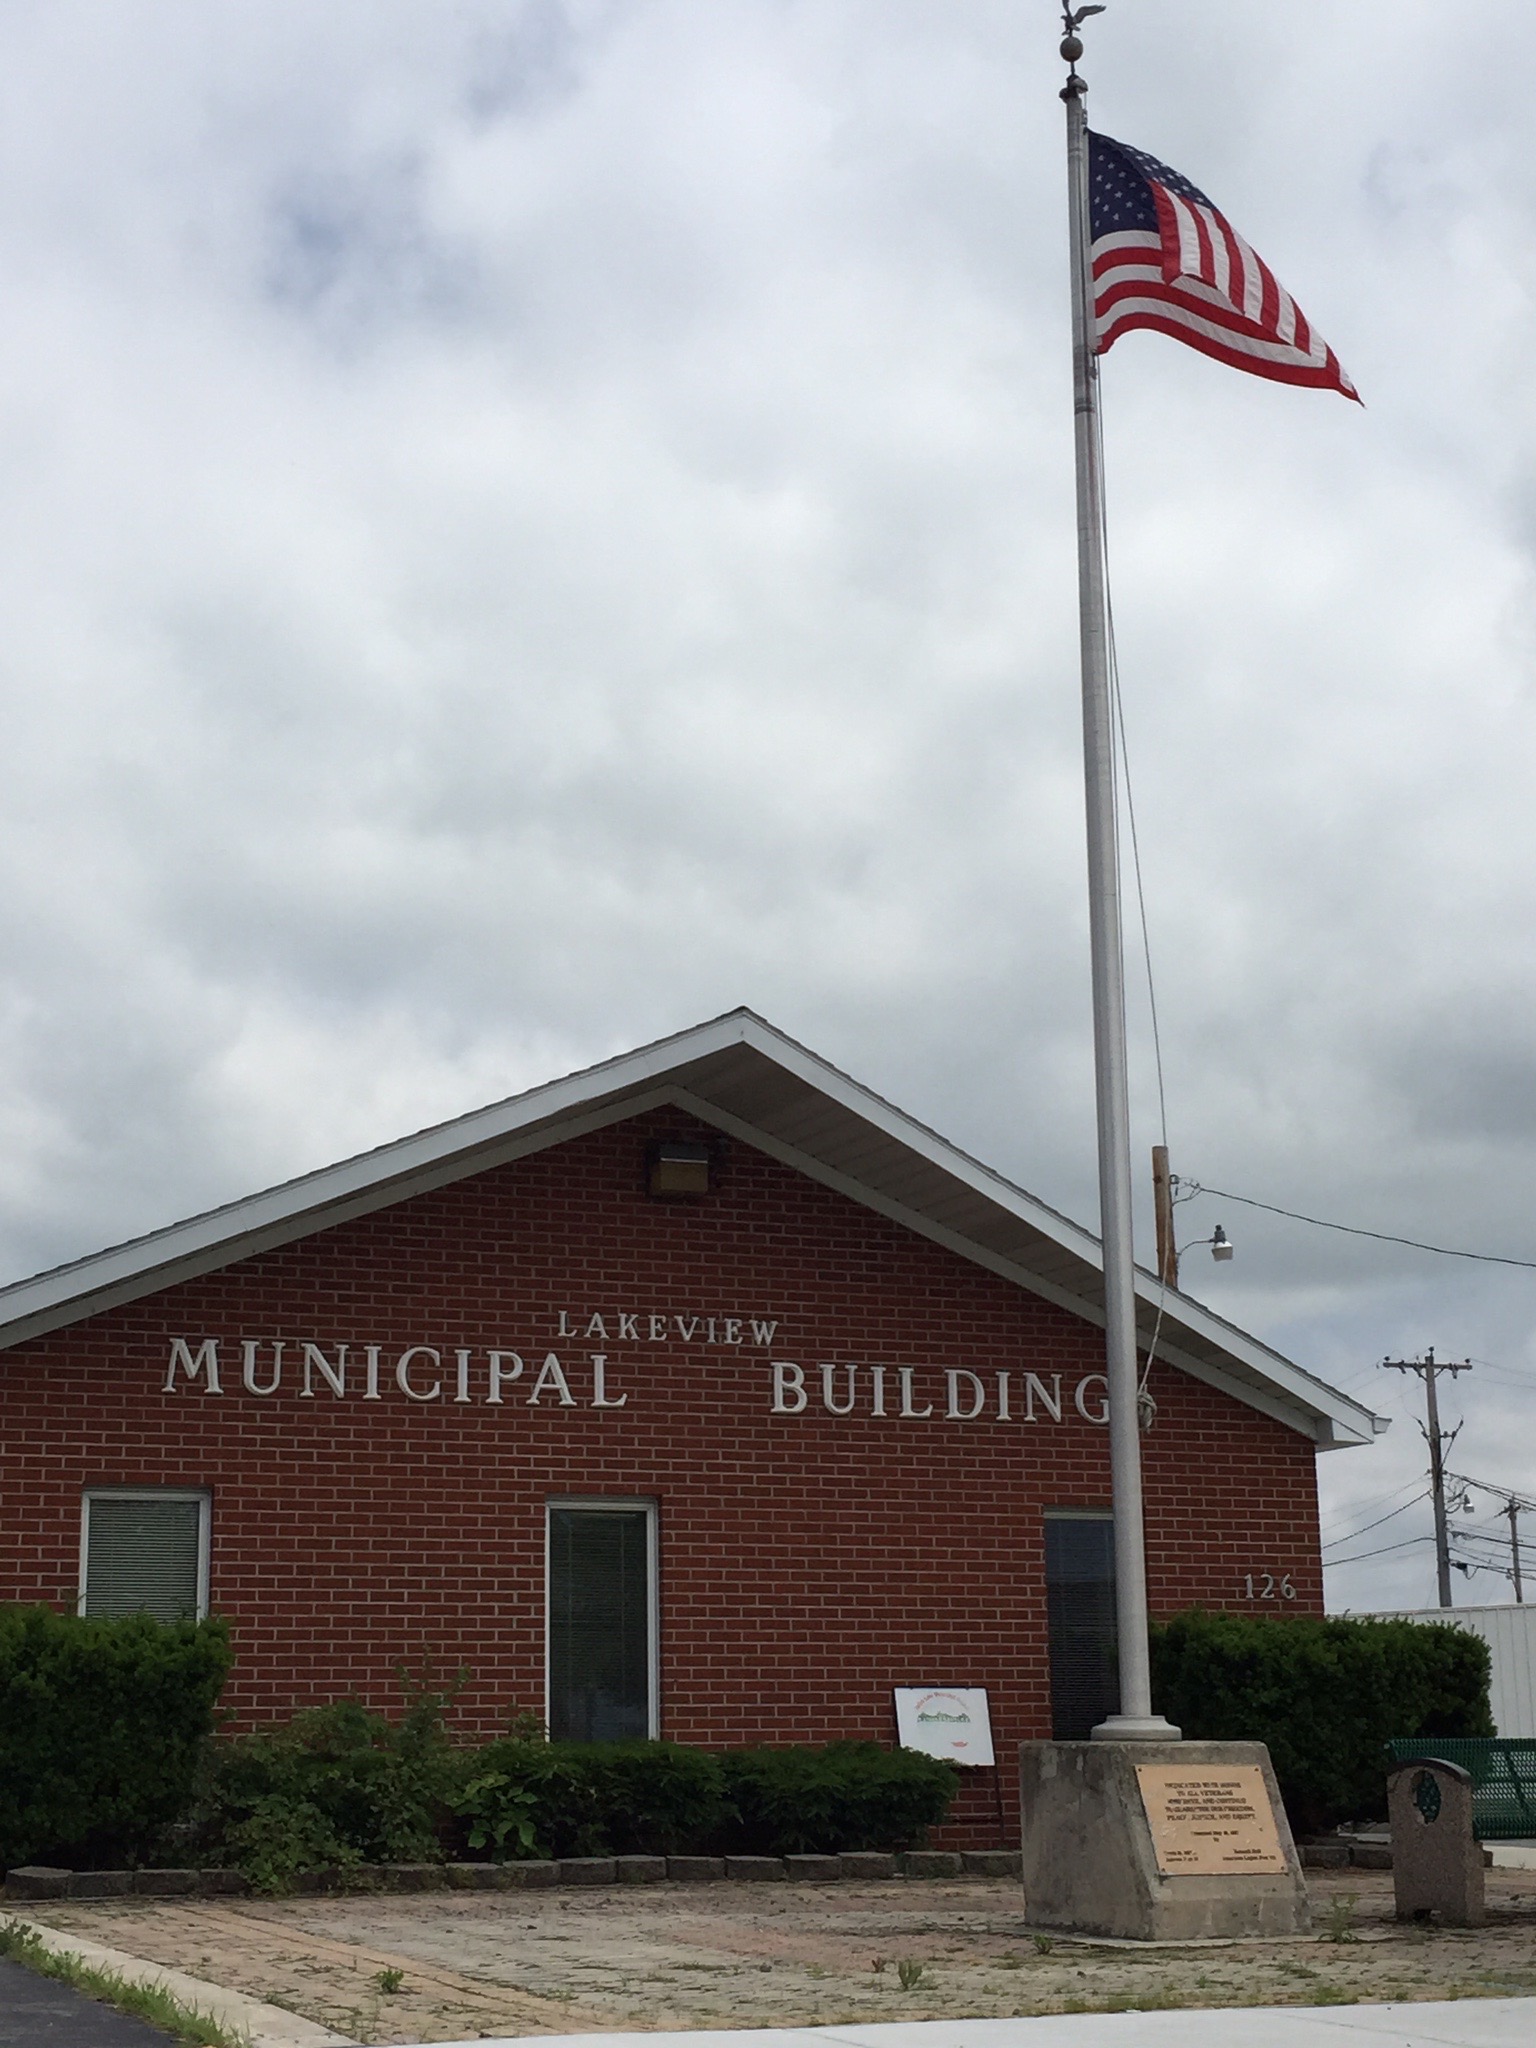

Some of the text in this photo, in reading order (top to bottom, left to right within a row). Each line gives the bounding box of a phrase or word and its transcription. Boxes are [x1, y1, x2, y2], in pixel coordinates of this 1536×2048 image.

[558, 1310, 779, 1346] LAKEVIEW
[161, 1337, 1109, 1425] MUNICIPAL BUILDING
[1244, 1573, 1297, 1600] 126
